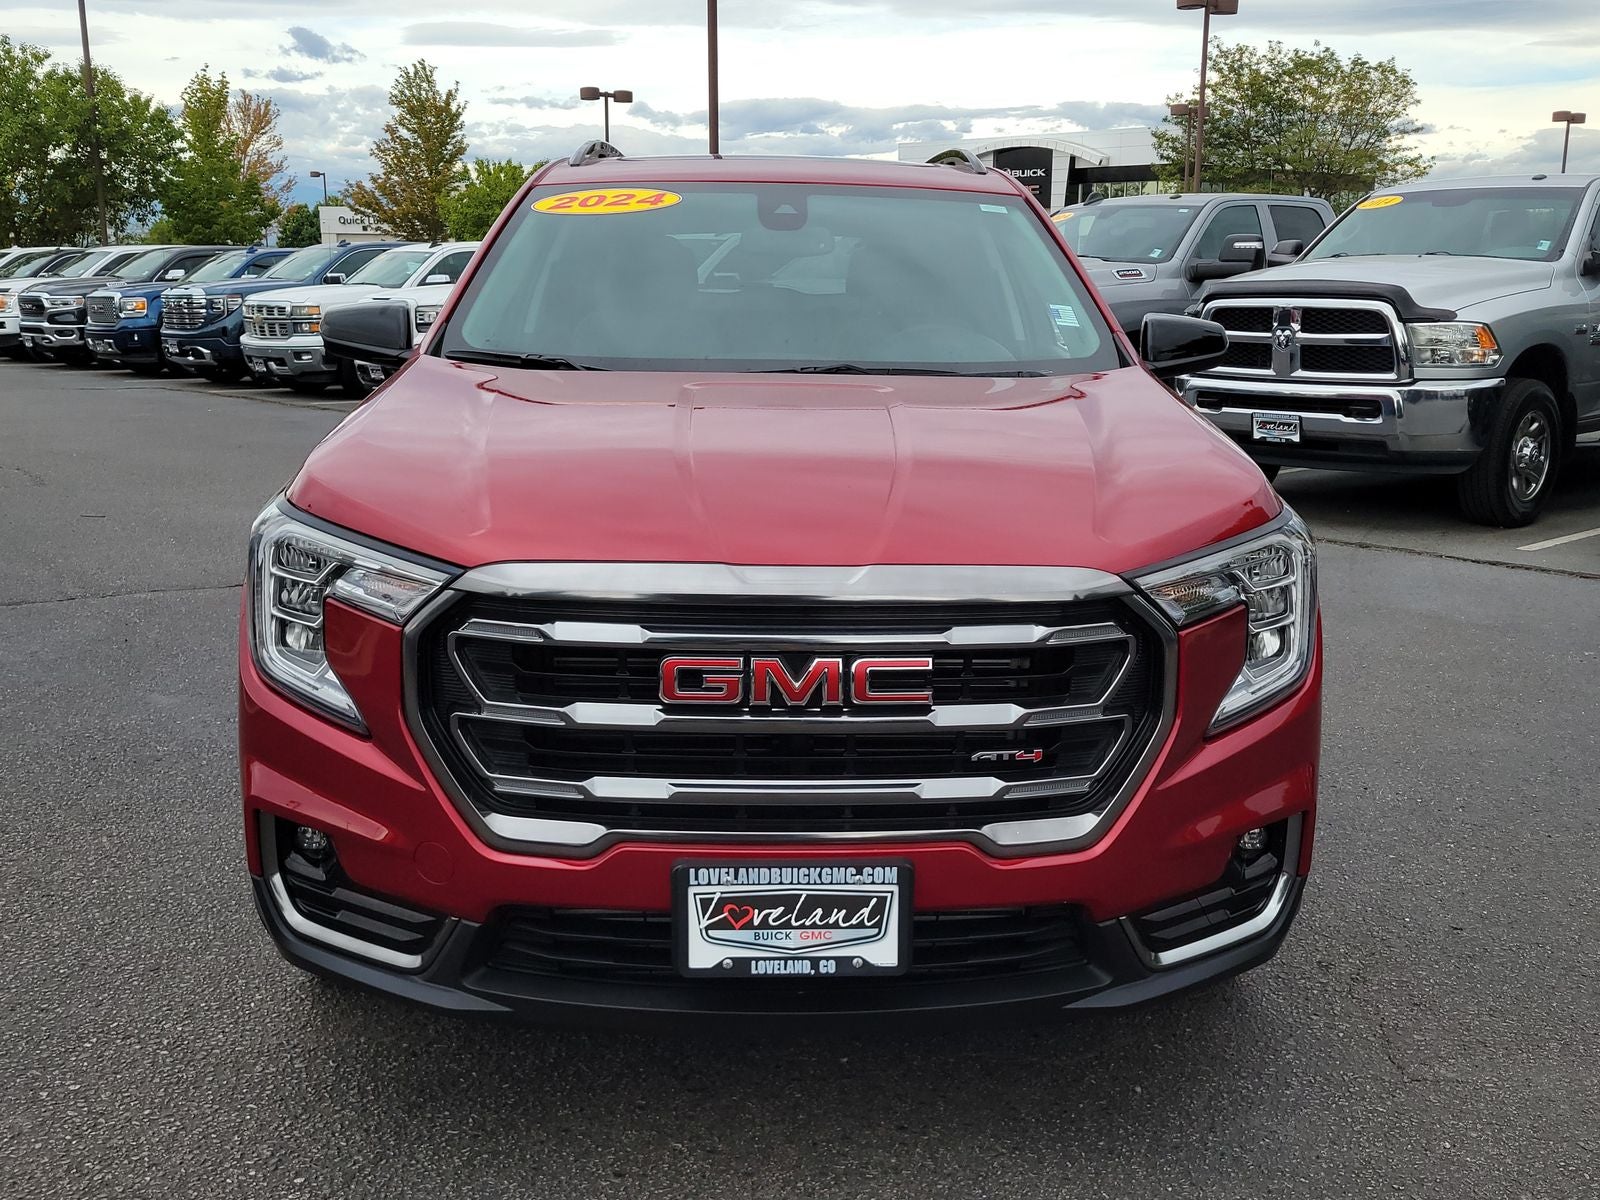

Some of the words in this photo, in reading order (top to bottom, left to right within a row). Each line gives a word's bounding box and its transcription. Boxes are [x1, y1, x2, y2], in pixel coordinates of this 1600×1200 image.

[1011, 168, 1046, 177] BUICK
[547, 193, 667, 211] 2024
[338, 216, 366, 226] Quick
[659, 655, 934, 707] GMC
[971, 749, 1043, 763] AT4
[689, 867, 898, 885] LOVELANDBUICKGMCCOM
[700, 892, 880, 930] Loveland
[753, 931, 792, 941] BUICK
[799, 930, 833, 941] GMC
[751, 960, 815, 975] LOVELAND,
[819, 960, 836, 974] CO
